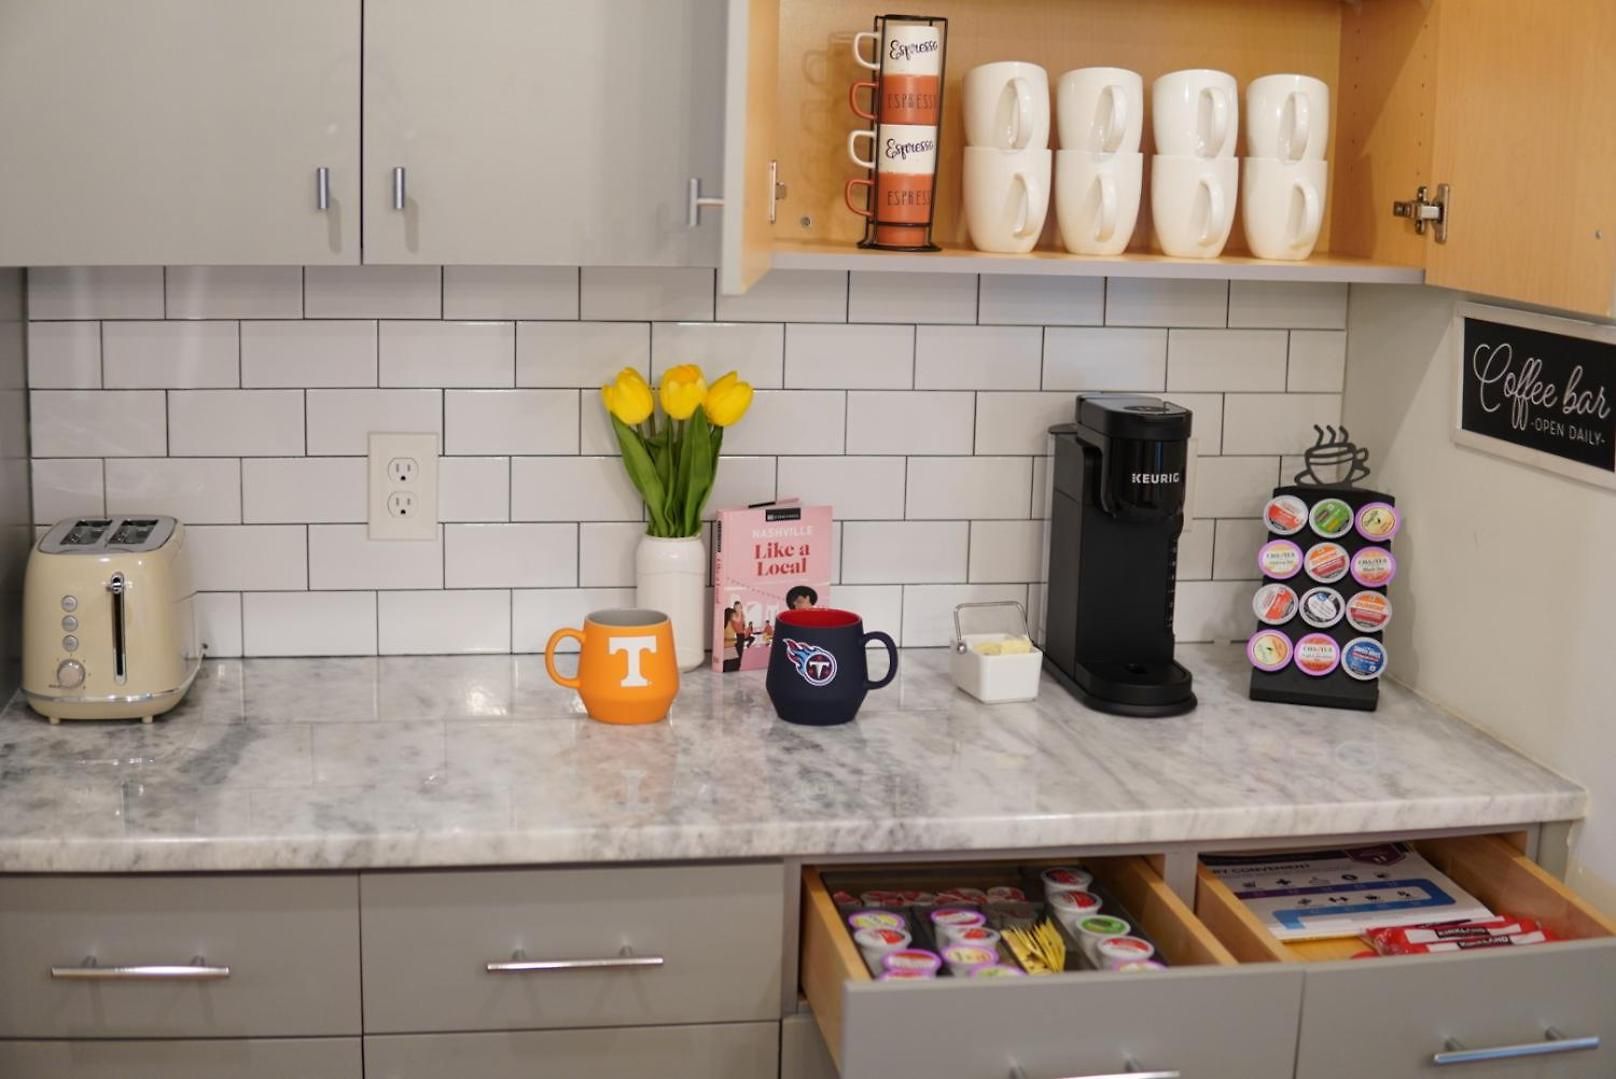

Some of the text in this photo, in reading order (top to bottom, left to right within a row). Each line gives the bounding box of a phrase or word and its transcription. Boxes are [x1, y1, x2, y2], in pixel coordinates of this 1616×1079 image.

[889, 39, 938, 60] Espresso
[885, 138, 933, 160] Espresso
[1473, 343, 1611, 430] Coffee bar
[1132, 472, 1180, 484] KEURIG
[752, 525, 814, 539] NASHVILLE
[755, 543, 810, 559] Like a
[757, 558, 807, 577] Local
[609, 635, 657, 687] T
